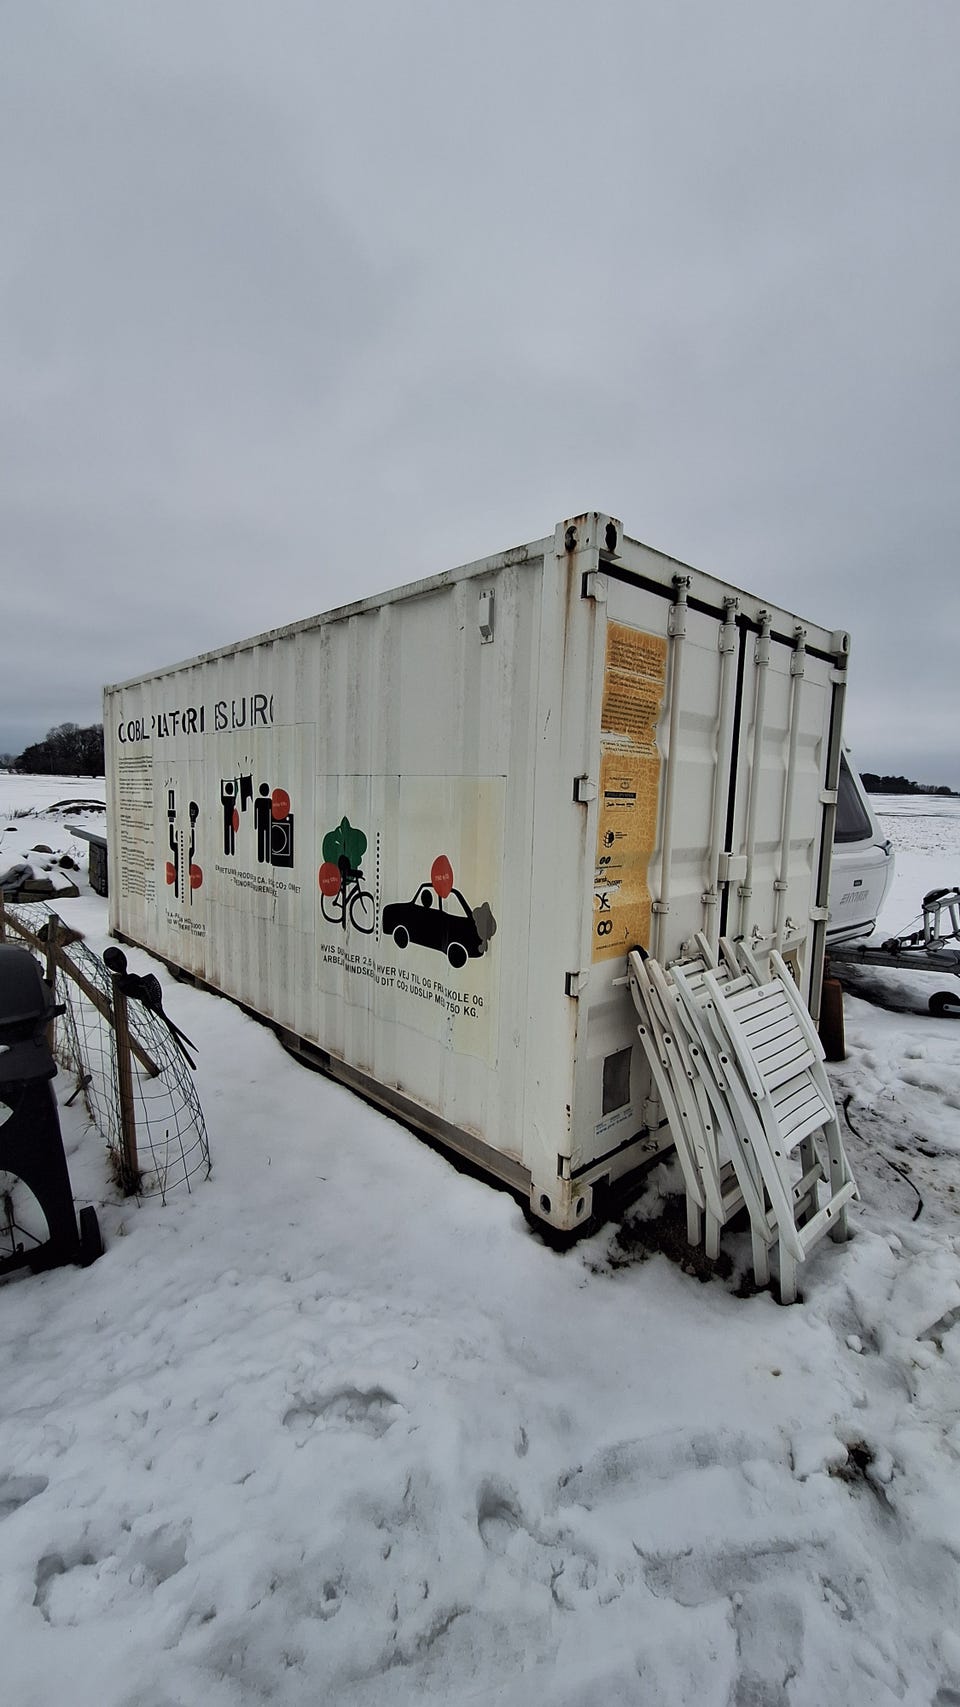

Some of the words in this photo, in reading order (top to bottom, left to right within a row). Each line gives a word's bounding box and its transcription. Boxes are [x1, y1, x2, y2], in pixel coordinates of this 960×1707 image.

[320, 943, 336, 954] HVIS
[376, 965, 397, 977] HVER
[398, 968, 410, 981] VEJ
[411, 973, 421, 984] TIL
[422, 977, 432, 989] OG
[444, 985, 469, 1003] SKOLE
[472, 994, 484, 1007] OG
[381, 977, 394, 988] DIT
[409, 985, 434, 1001] UDSLIP
[445, 1001, 461, 1014] 750
[463, 1006, 479, 1019] KG.
